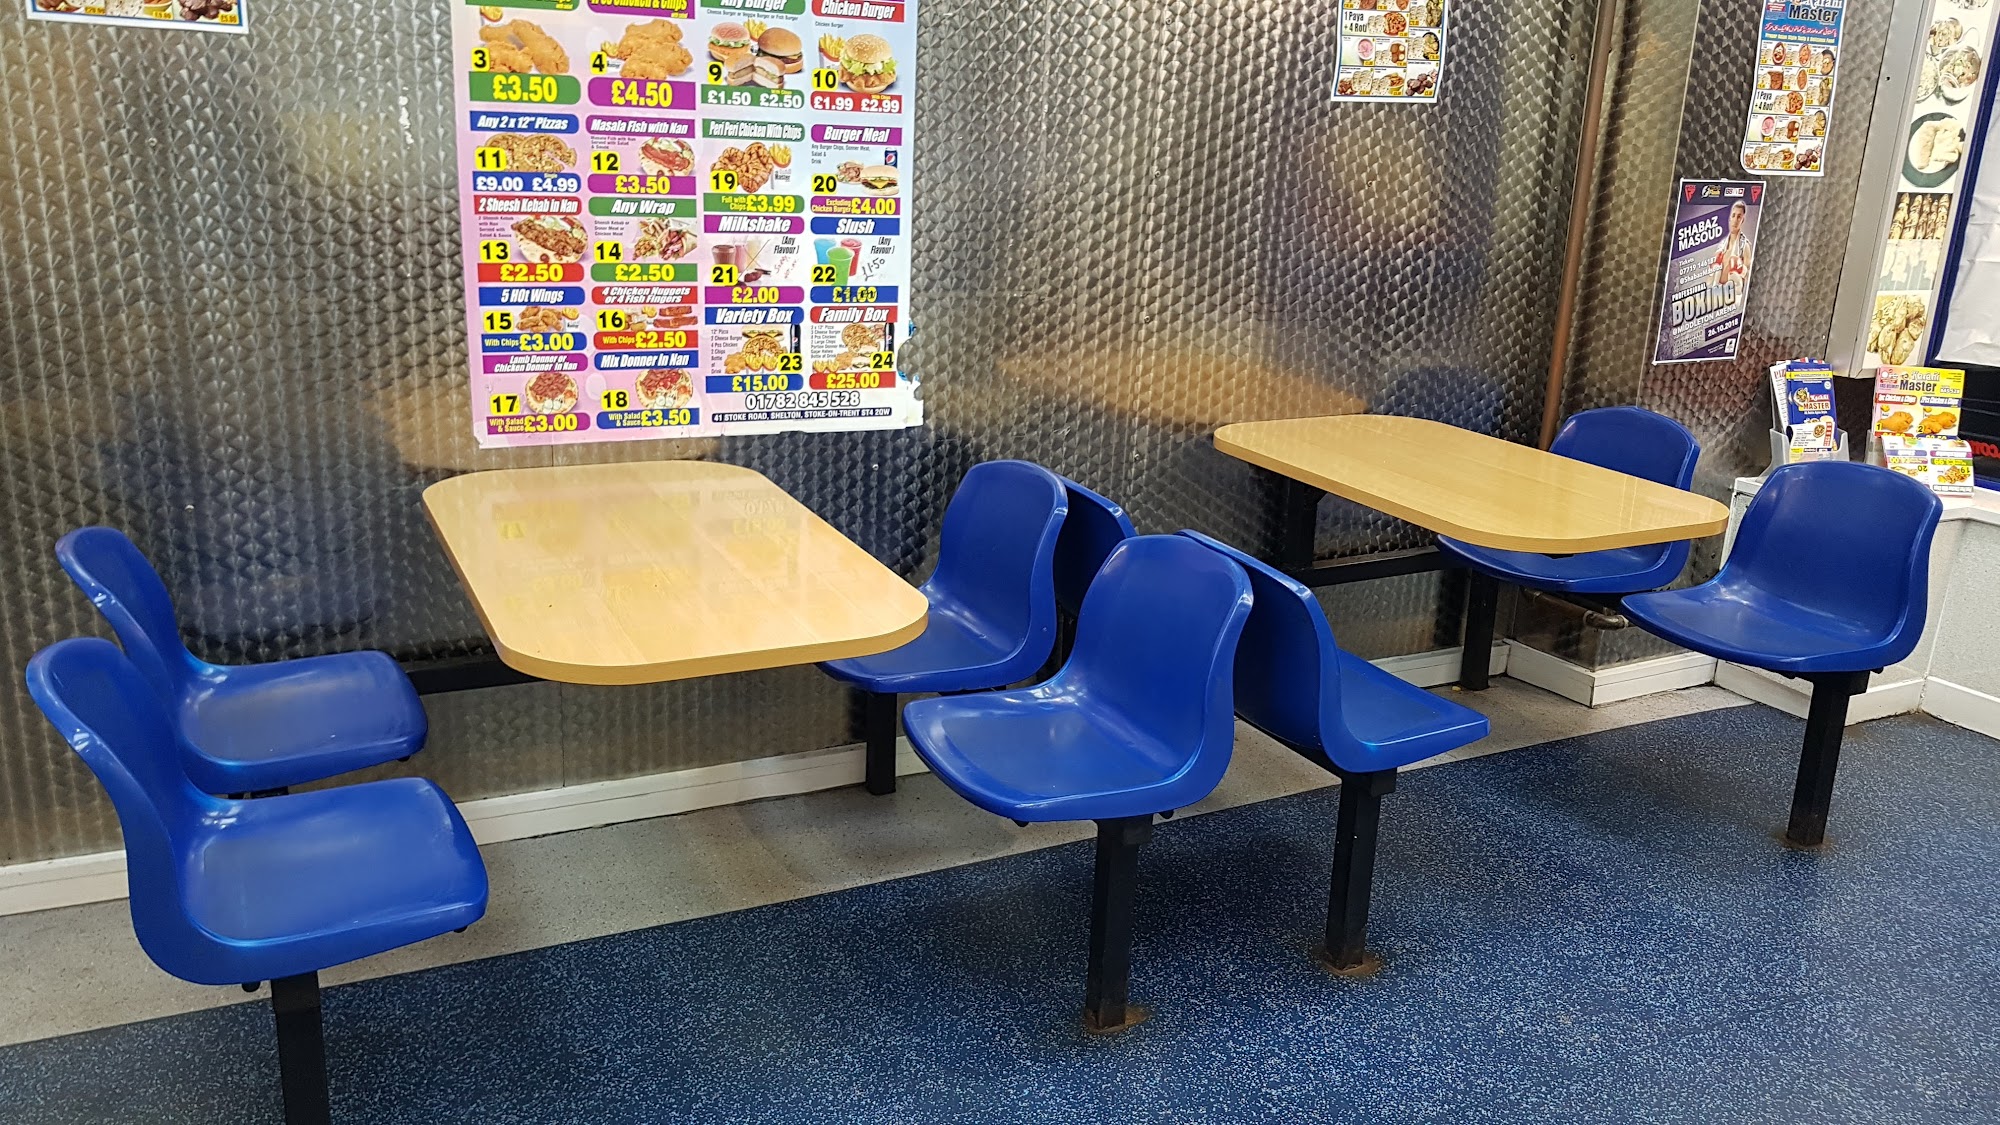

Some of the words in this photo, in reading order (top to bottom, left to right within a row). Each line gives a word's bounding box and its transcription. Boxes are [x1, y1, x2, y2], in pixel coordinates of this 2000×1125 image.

[821, 0, 861, 16] Chicken
[862, 2, 895, 19] Burger
[1348, 12, 1364, 22] Paya
[1789, 5, 1838, 22] Master
[1349, 23, 1353, 32] 4
[1354, 24, 1367, 32] Roti
[473, 50, 486, 68] 3
[592, 54, 604, 72] 4
[710, 64, 722, 81] 9
[814, 71, 836, 88] 10
[492, 74, 558, 102] £3.50
[611, 80, 672, 107] £4.50
[1761, 91, 1772, 100] Paya
[707, 90, 751, 106] £1.50
[760, 94, 800, 108] £2.50
[813, 96, 854, 110] £1.99
[860, 99, 900, 113] £2.99
[1759, 102, 1762, 110] 4
[477, 115, 499, 129] Any
[500, 115, 509, 128] 2
[508, 118, 516, 128] x
[534, 117, 568, 130] Pizzas
[590, 118, 627, 131] Masala
[627, 120, 648, 133] Fish
[648, 121, 668, 133] with
[668, 123, 688, 134] Nan
[709, 121, 725, 136] Peri
[725, 122, 738, 136] Peri
[738, 122, 766, 138] Chicken
[767, 124, 782, 138] With
[782, 125, 802, 140] Chips
[824, 126, 862, 142] Burger
[862, 128, 890, 142] Meal
[478, 150, 501, 168] 11
[594, 153, 618, 171] 12
[476, 176, 524, 191] £9.00
[532, 177, 578, 192] £4.99
[615, 176, 670, 194] £3.50
[712, 173, 735, 190] 19
[814, 176, 837, 192] 20
[479, 199, 486, 212] 2
[485, 199, 521, 212] Sheesh
[521, 199, 550, 212] Kebab
[550, 200, 559, 213] in
[560, 200, 578, 213] Nan
[611, 200, 640, 215] Any
[639, 200, 676, 216] Wrap
[746, 194, 795, 213] £3.99
[826, 199, 851, 207] Excluding
[851, 198, 896, 215] £4.00
[718, 216, 792, 233] Milkshake
[836, 218, 876, 234] Slush
[1678, 216, 1718, 240] SHABAZ
[781, 236, 796, 245] (Any
[878, 237, 891, 246] (Any
[1679, 226, 1722, 251] MASOUD
[482, 243, 508, 260] 13
[596, 243, 621, 260] 14
[774, 245, 796, 254] Flavour
[870, 246, 891, 254] Flavour
[500, 263, 564, 282] £2.50
[615, 264, 675, 282] £2.50
[712, 267, 734, 283] 21
[813, 266, 835, 282] 22
[1680, 265, 1696, 275] 07719
[501, 290, 508, 302] 5
[530, 289, 564, 304] Wings
[602, 287, 608, 295] 4
[609, 287, 649, 295] Chicken
[650, 287, 690, 296] Nuggets
[617, 295, 623, 303] 4
[624, 295, 645, 304] Fish
[646, 295, 682, 304] Fingers
[731, 288, 779, 304] £2.00
[1672, 283, 1706, 301] PROFESSIONAL
[1672, 280, 1735, 326] BOXING
[486, 313, 512, 329] 15
[599, 312, 622, 328] 16
[716, 308, 765, 323] Variety
[767, 308, 794, 323] Box
[819, 308, 862, 324] Family
[863, 308, 889, 322] Box
[1672, 314, 1714, 335] @MIDDLETON
[1716, 305, 1736, 318] ARENA
[501, 338, 519, 347] Chips
[519, 333, 574, 351] £3.00
[603, 336, 617, 344] With
[618, 336, 635, 345] Chips
[635, 331, 687, 348] £2.50
[494, 364, 524, 372] Chicken
[526, 363, 553, 372] Donner
[554, 363, 562, 371] in
[562, 362, 578, 370] Nan
[531, 355, 558, 363] Donner
[601, 355, 621, 368] Mix
[622, 354, 656, 367] Donner
[658, 354, 669, 366] in
[669, 354, 689, 366] Nan
[780, 356, 802, 371] 23
[872, 354, 894, 368] 24
[732, 375, 788, 392] £15.00
[826, 373, 880, 388] £25.00
[1900, 380, 1937, 391] Master
[493, 396, 518, 413] 17
[603, 392, 627, 408] 18
[745, 393, 797, 410] 01782
[798, 392, 830, 408] 845
[830, 391, 861, 408] 528
[489, 418, 504, 426] With
[524, 413, 578, 432] £3.00
[622, 418, 641, 426] Sauce
[624, 412, 641, 420] Salad
[641, 410, 691, 426] £3.50
[748, 413, 769, 421] ROAD,
[771, 412, 803, 420] SHELTON,
[804, 410, 860, 418] STOKE-ON-TRENT
[504, 424, 524, 432] Sauce
